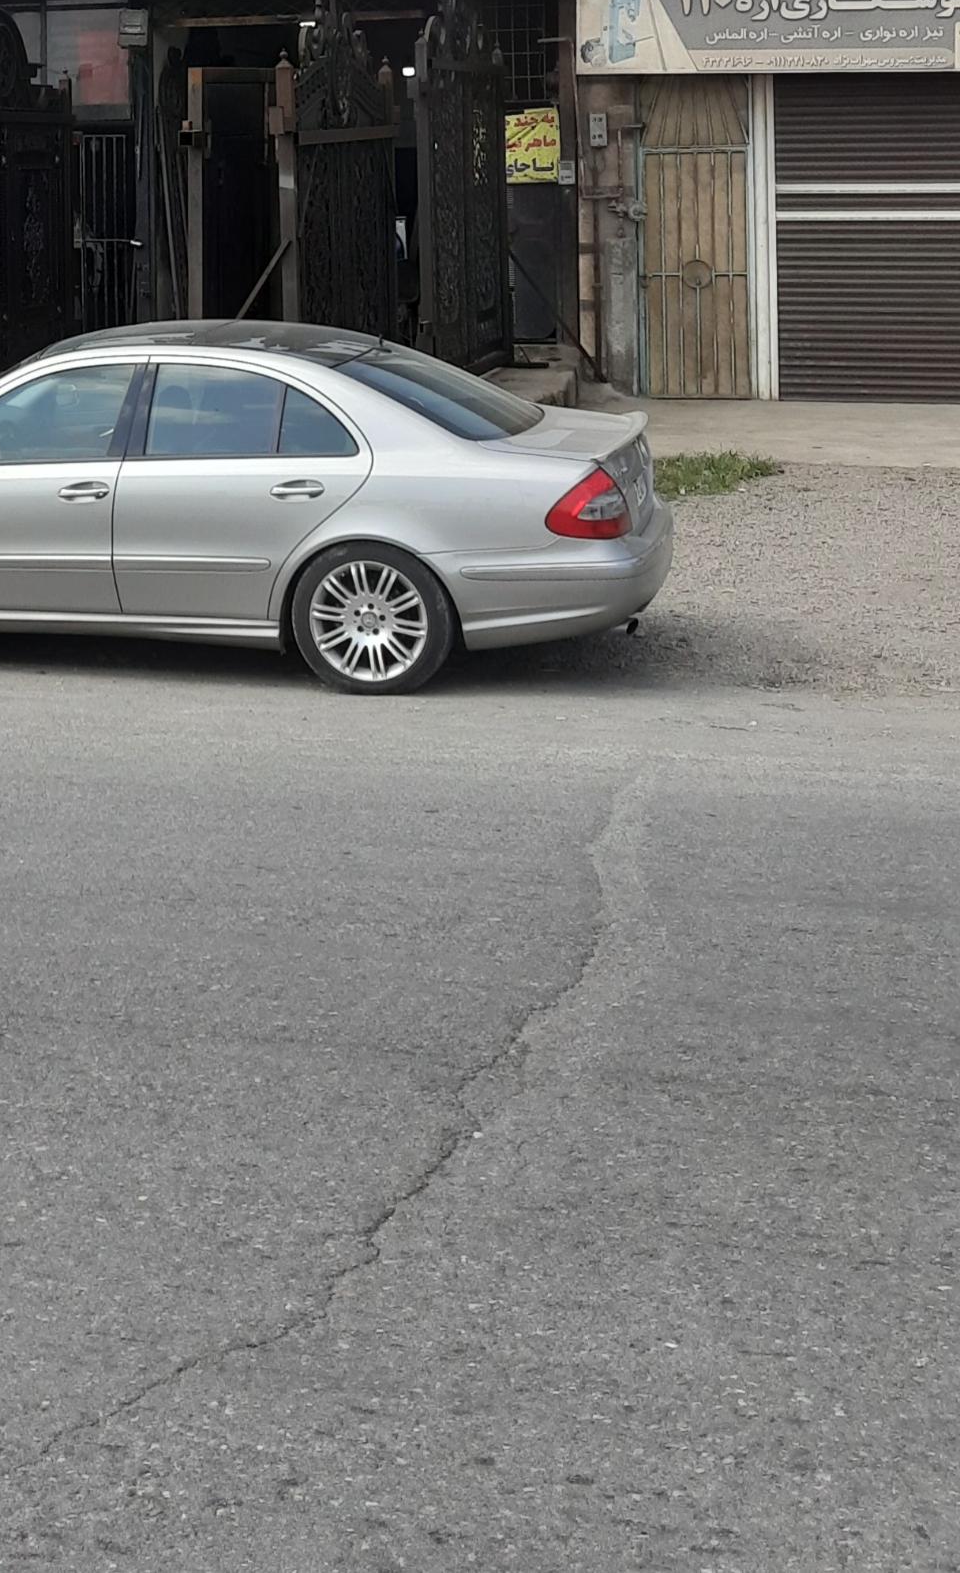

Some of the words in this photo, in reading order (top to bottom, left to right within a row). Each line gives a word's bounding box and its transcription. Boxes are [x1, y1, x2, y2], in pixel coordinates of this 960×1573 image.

[705, 27, 747, 45] الماس
[748, 27, 768, 42] اره
[781, 24, 821, 43] آتشی
[822, 25, 841, 41] اره
[860, 26, 897, 42] نواری
[899, 25, 919, 40] اره
